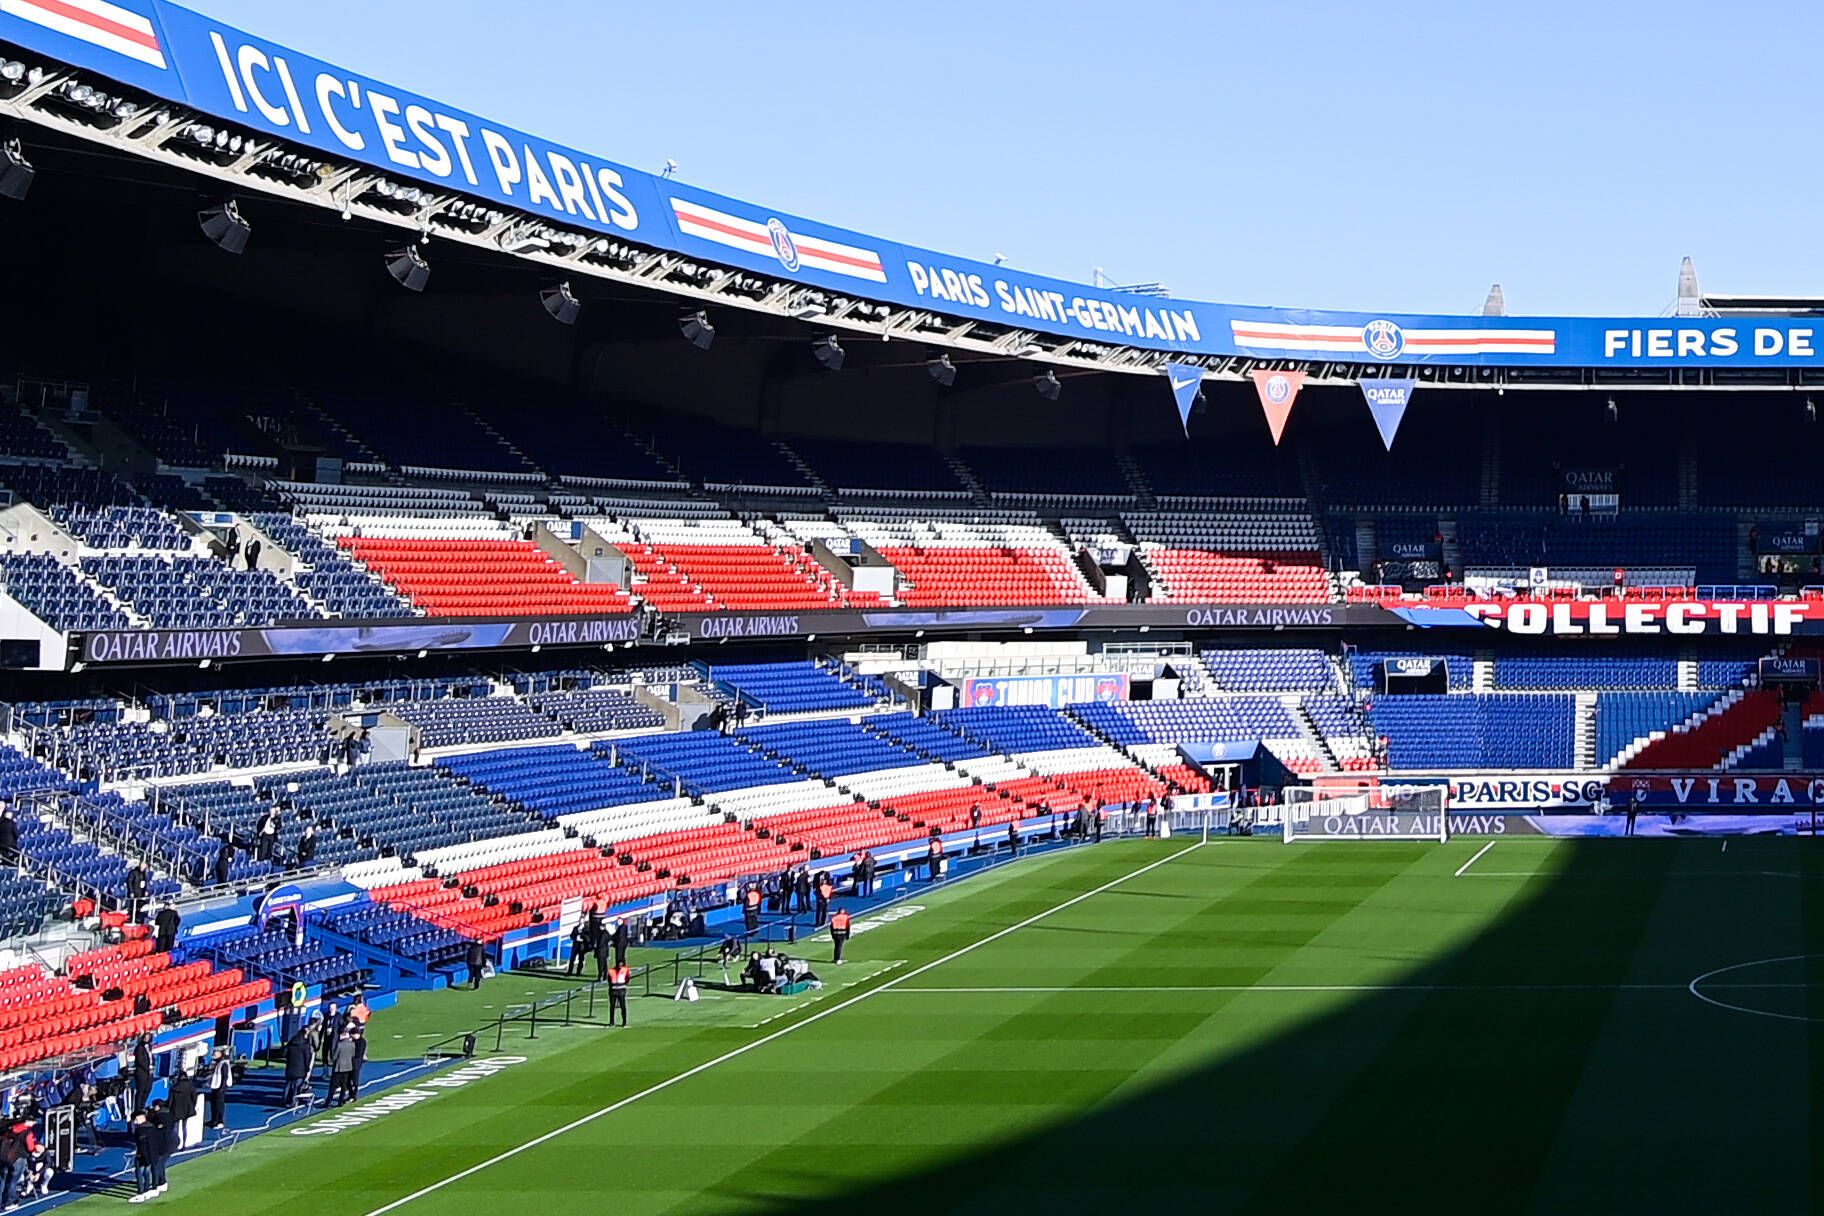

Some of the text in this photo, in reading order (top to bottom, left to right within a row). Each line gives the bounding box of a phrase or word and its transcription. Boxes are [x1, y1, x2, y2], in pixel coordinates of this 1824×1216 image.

[209, 30, 640, 232] ICI C'EST PARIS
[907, 261, 1201, 343] PARIS SAINT-GERMAIN
[1605, 329, 1736, 358] FIERS
[1754, 329, 1814, 357] DE
[1367, 388, 1405, 400] QATAR
[1566, 471, 1613, 485] QATAR
[826, 537, 849, 549] QATAR
[1393, 544, 1424, 554] QATAR
[1773, 536, 1804, 548] QATAR
[700, 615, 800, 639] QATAR AIRWAYS
[1187, 609, 1332, 626] QATAR AIRWAYS
[529, 618, 639, 646] QATAR AIRWAYS
[90, 630, 242, 662] QATAR AIRWAYS
[1397, 659, 1431, 673] QATAR
[1773, 659, 1805, 672] QATAR
[1457, 781, 1551, 802] PARIS
[1324, 815, 1505, 835] QATAR AIRWAYS
[290, 1056, 528, 1136] QATAR AIRWAYS
